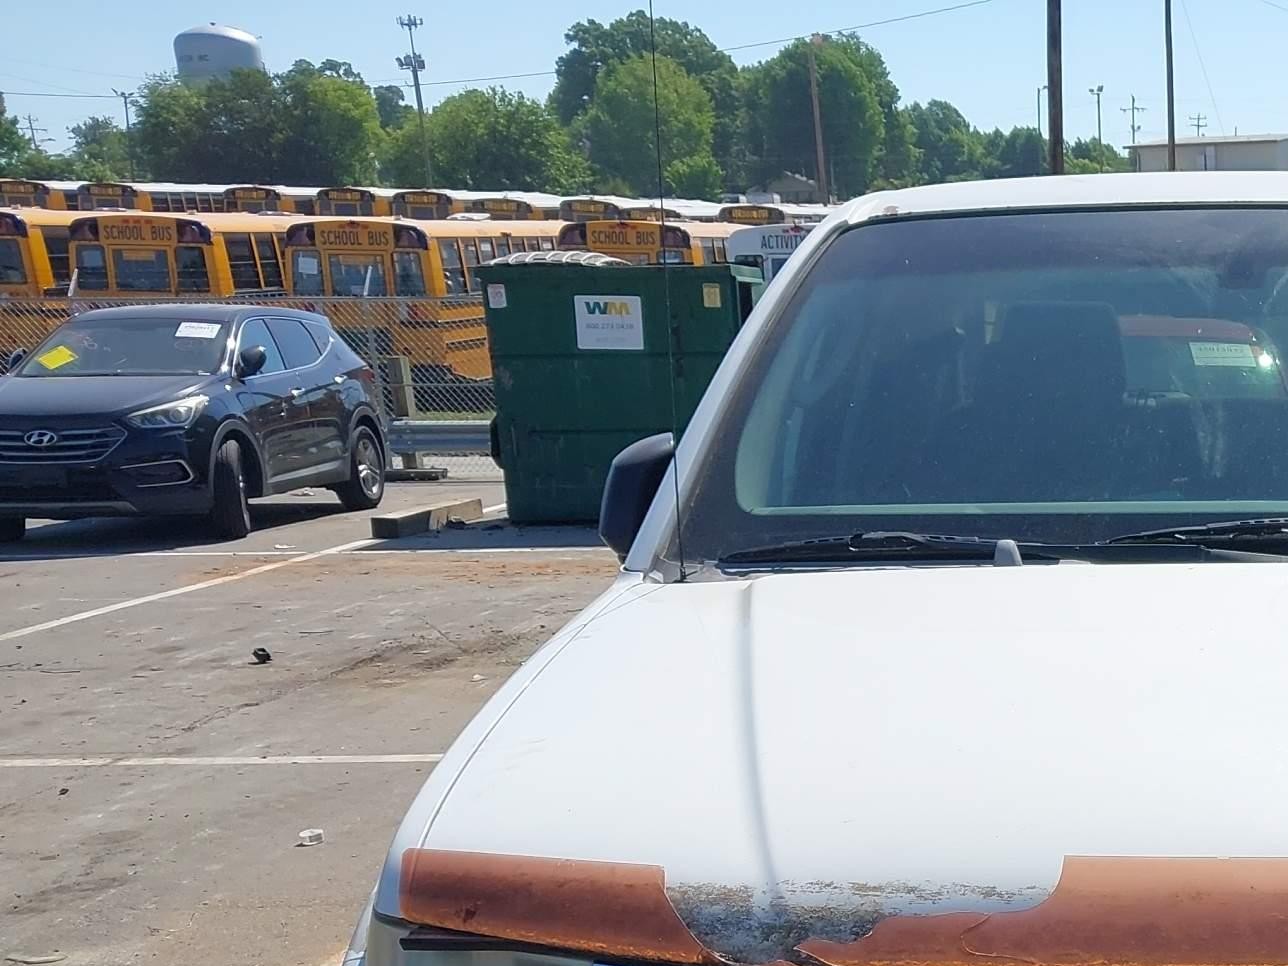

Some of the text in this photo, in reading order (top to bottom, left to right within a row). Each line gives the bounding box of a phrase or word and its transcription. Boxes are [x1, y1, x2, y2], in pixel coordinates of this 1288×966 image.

[103, 224, 172, 241] SCHOOL BUS
[319, 229, 389, 246] SCHOOL BUS
[591, 230, 656, 245] SCHOOL BUS
[584, 301, 632, 315] WM
